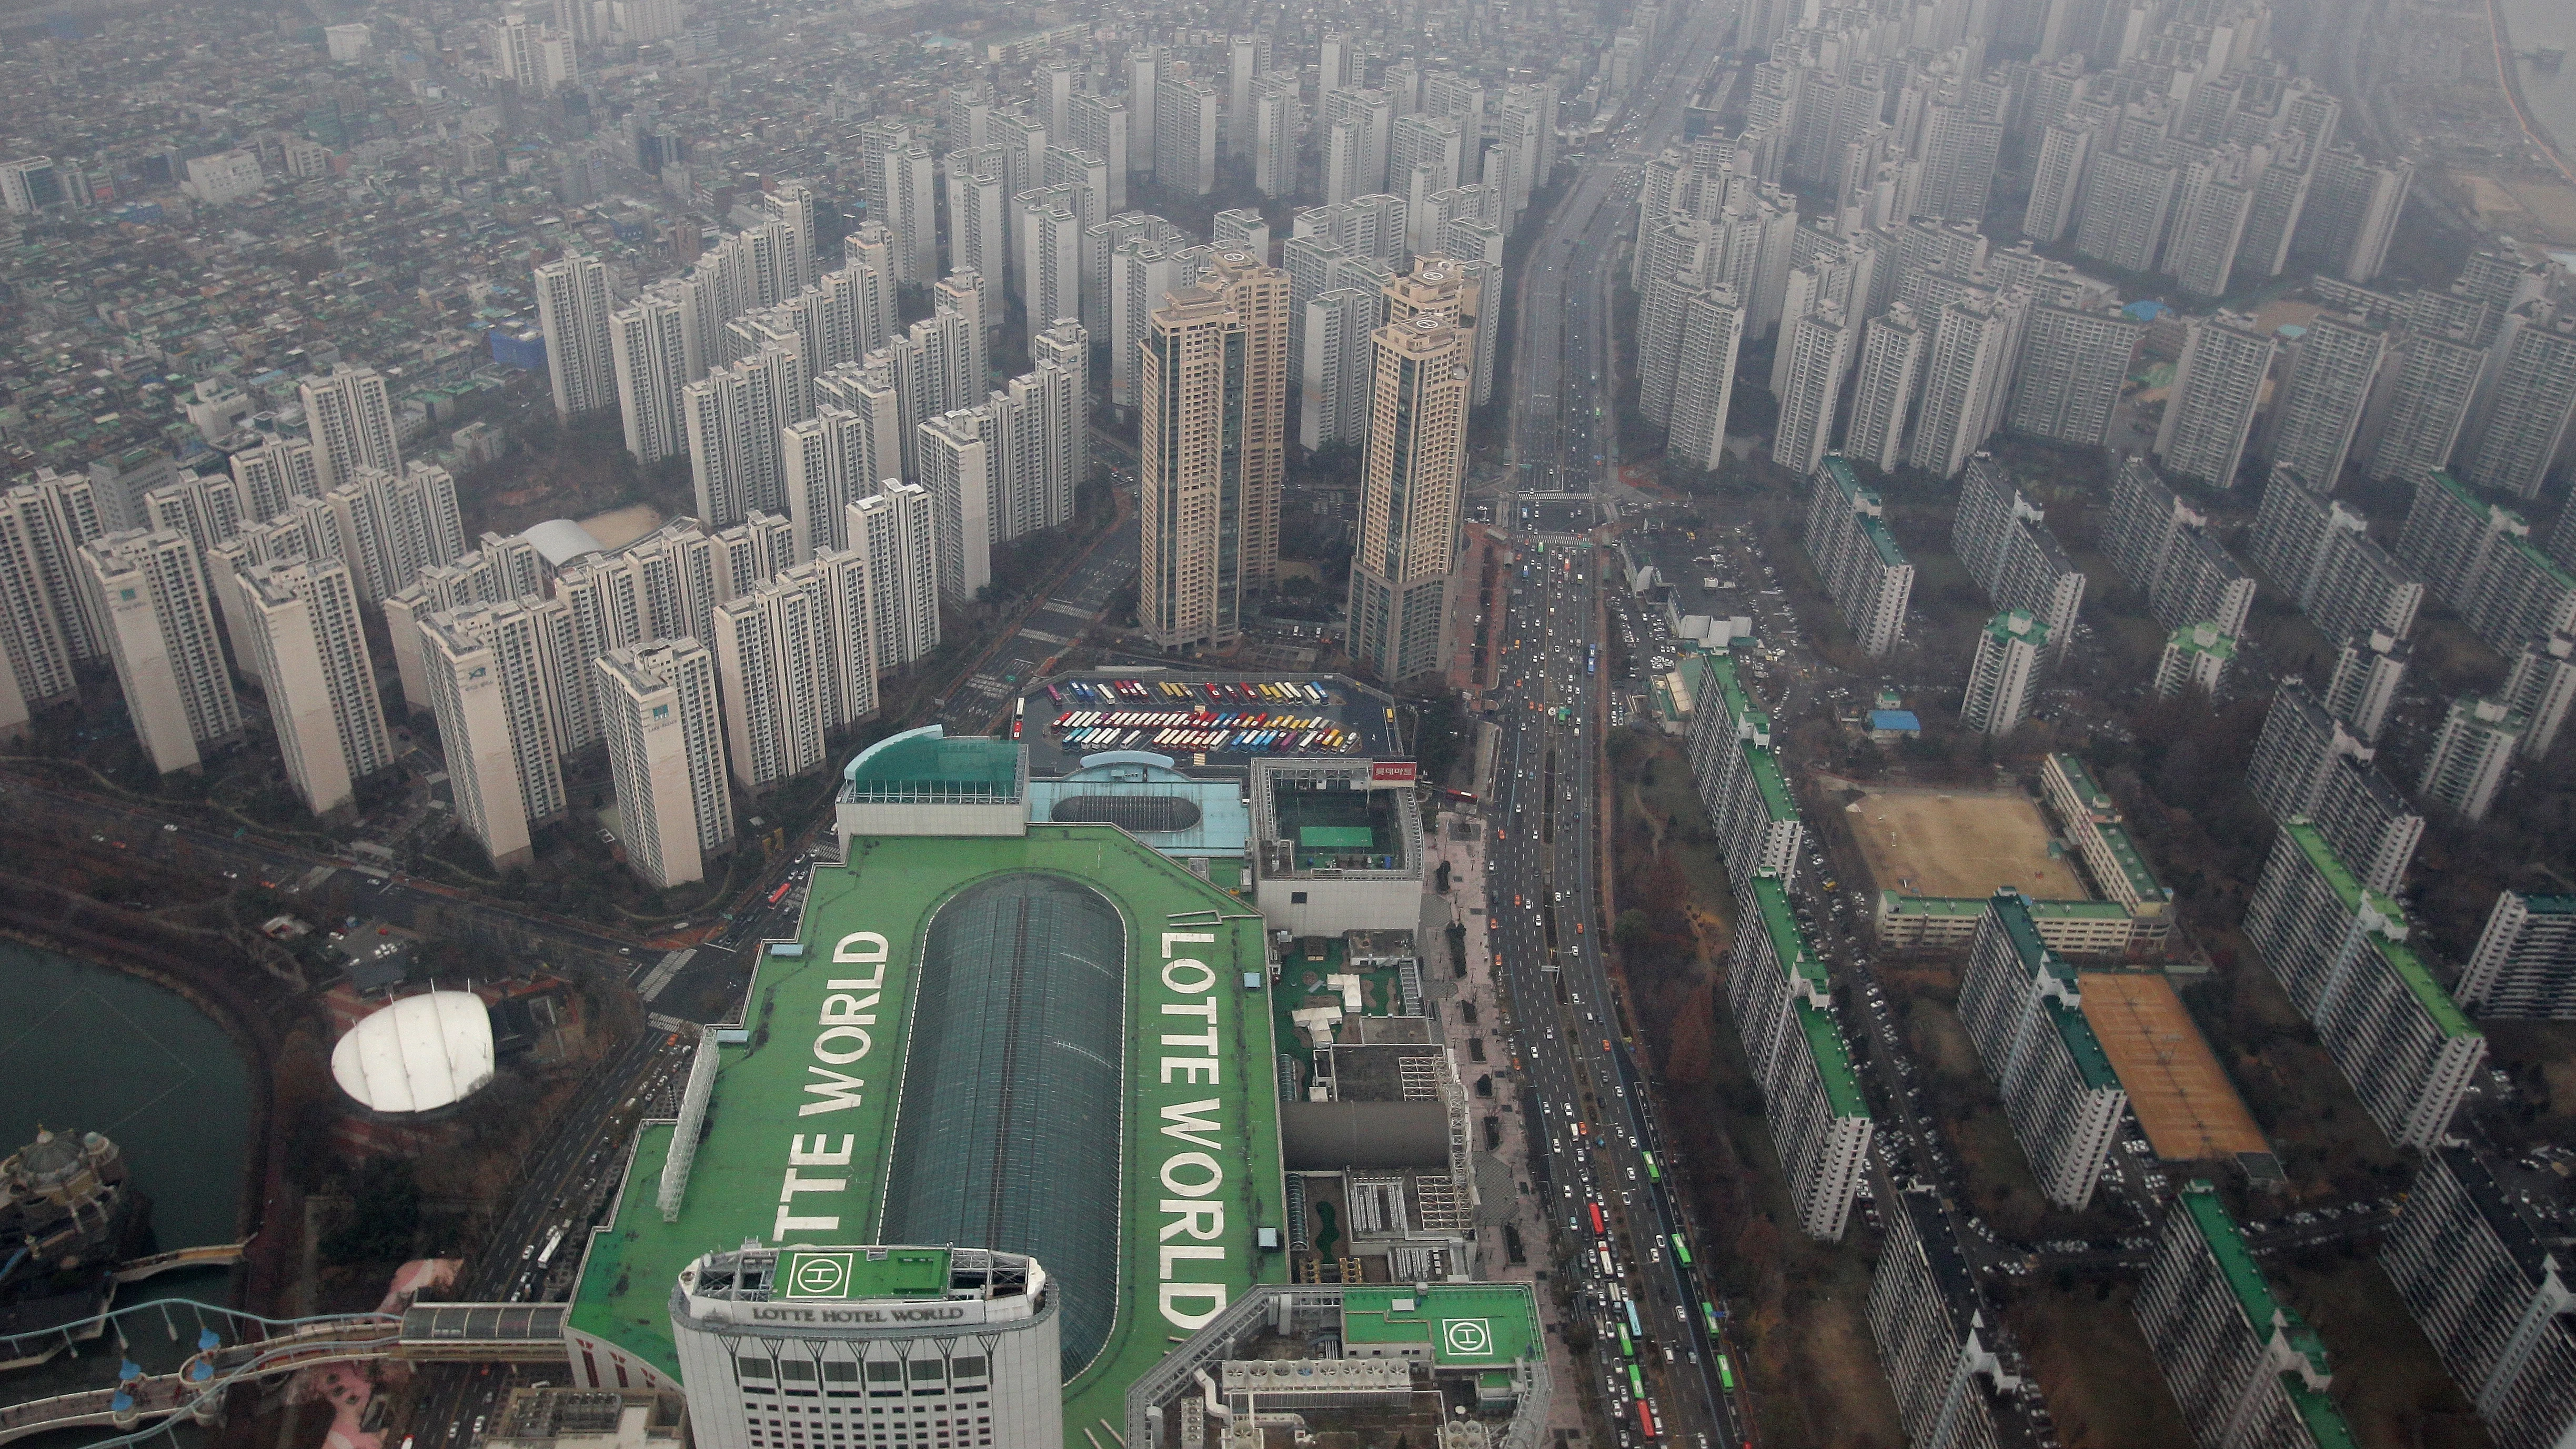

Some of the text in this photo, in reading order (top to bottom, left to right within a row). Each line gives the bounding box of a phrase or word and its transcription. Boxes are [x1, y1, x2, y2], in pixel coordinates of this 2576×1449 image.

[772, 931, 889, 1250] TTE WORLD
[1159, 932, 1226, 1330] LOTTE WORLD
[753, 1306, 963, 1322] LOTTE HOTEL WORLD
